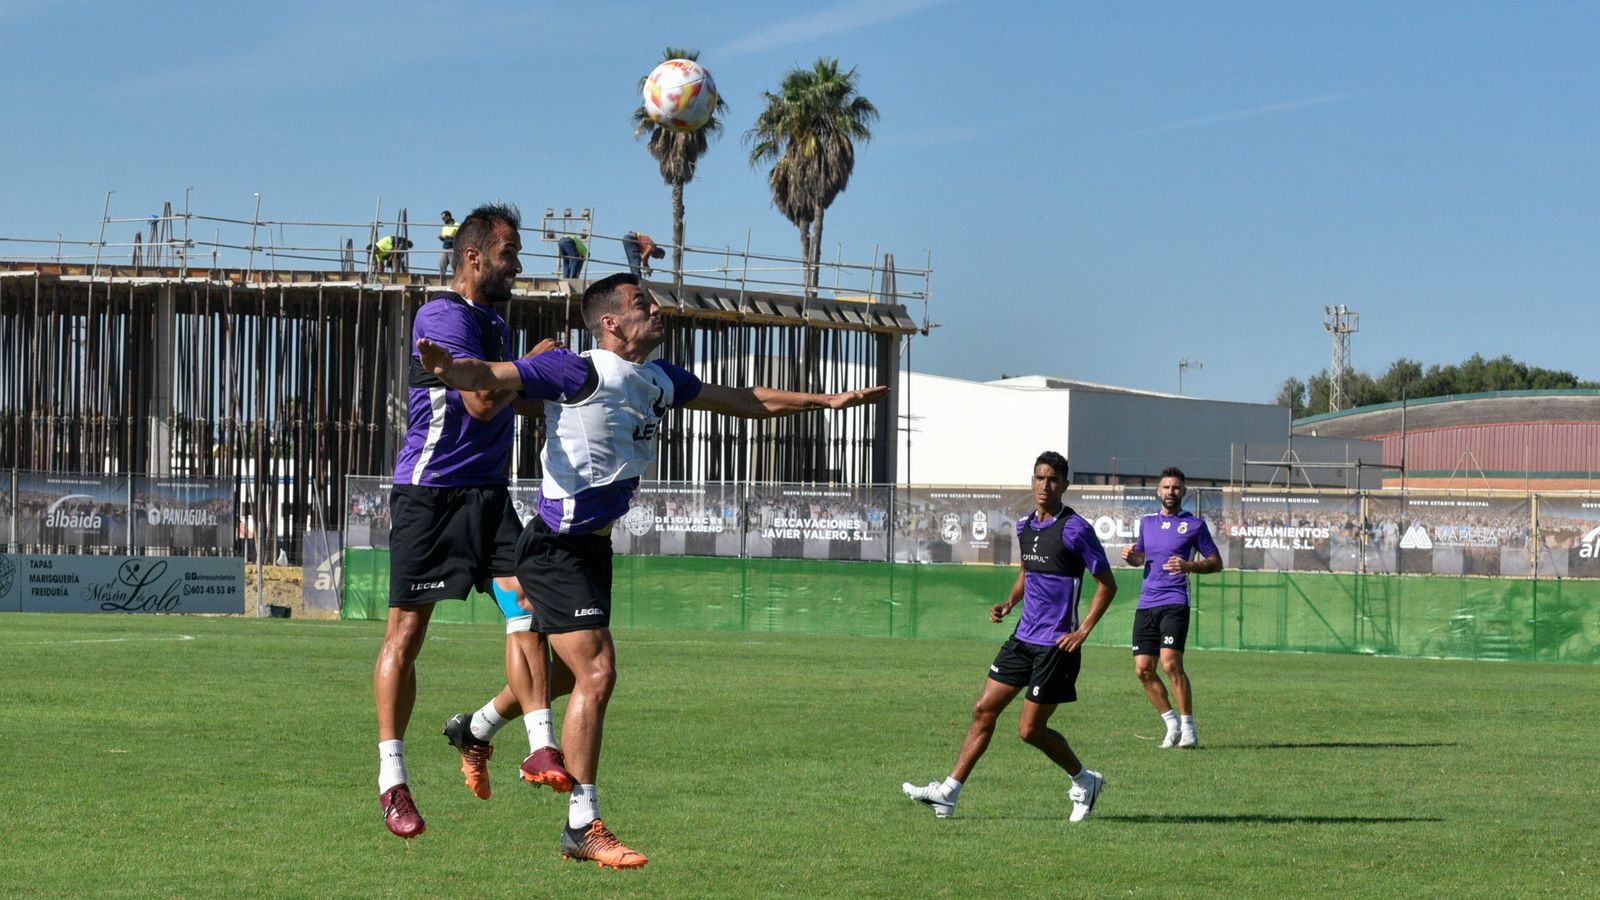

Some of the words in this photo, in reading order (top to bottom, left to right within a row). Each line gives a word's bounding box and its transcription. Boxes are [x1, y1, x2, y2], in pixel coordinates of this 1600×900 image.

[46, 509, 102, 529] albaida
[162, 508, 207, 526] PANIAGUA
[654, 516, 723, 525] DESGUACES
[655, 524, 665, 532] EL
[773, 518, 861, 530] EXCAVACIONES
[761, 528, 800, 539] JAVIER
[802, 529, 851, 542] VALERO,
[853, 530, 873, 541] S.L.
[1230, 525, 1330, 539] SANEAMIENTOS
[1244, 538, 1291, 550] ZABAL,
[1293, 539, 1315, 550] S.L.
[29, 560, 53, 569] TAPAS
[29, 572, 80, 584] MARISQUERÍA
[31, 585, 69, 597] FREIDURÍA
[100, 559, 182, 612] Lolo
[191, 585, 205, 594] 603
[206, 585, 215, 594] 45
[216, 585, 225, 594] 53
[227, 585, 236, 594] 89
[1163, 635, 1174, 645] 20
[1033, 685, 1040, 696] 6
